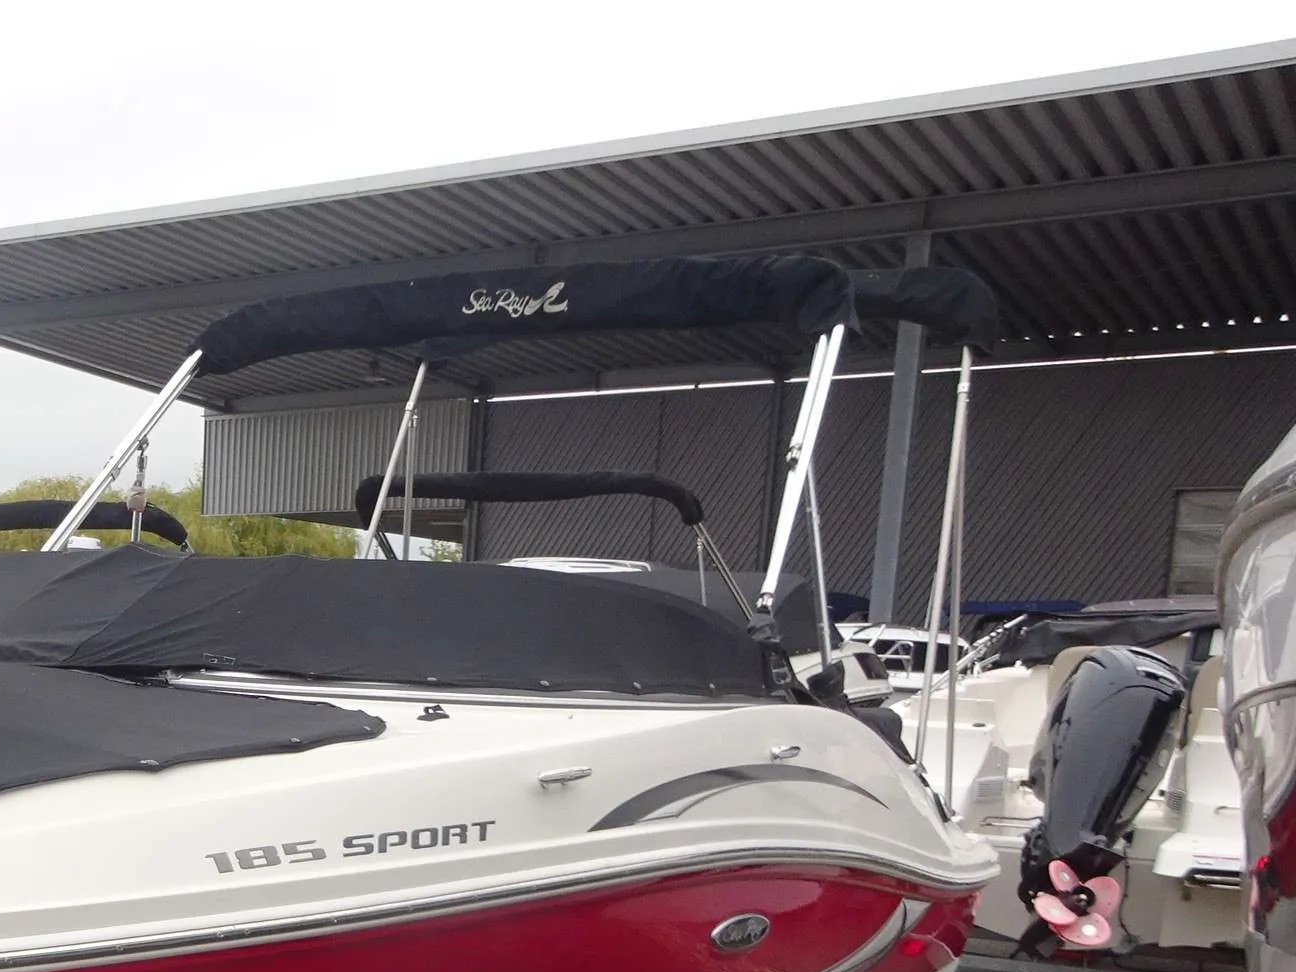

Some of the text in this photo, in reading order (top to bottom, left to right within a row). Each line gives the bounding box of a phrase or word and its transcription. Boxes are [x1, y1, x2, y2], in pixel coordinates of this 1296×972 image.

[462, 288, 529, 318] Sea Ray
[205, 820, 497, 875] 185 SPORT
